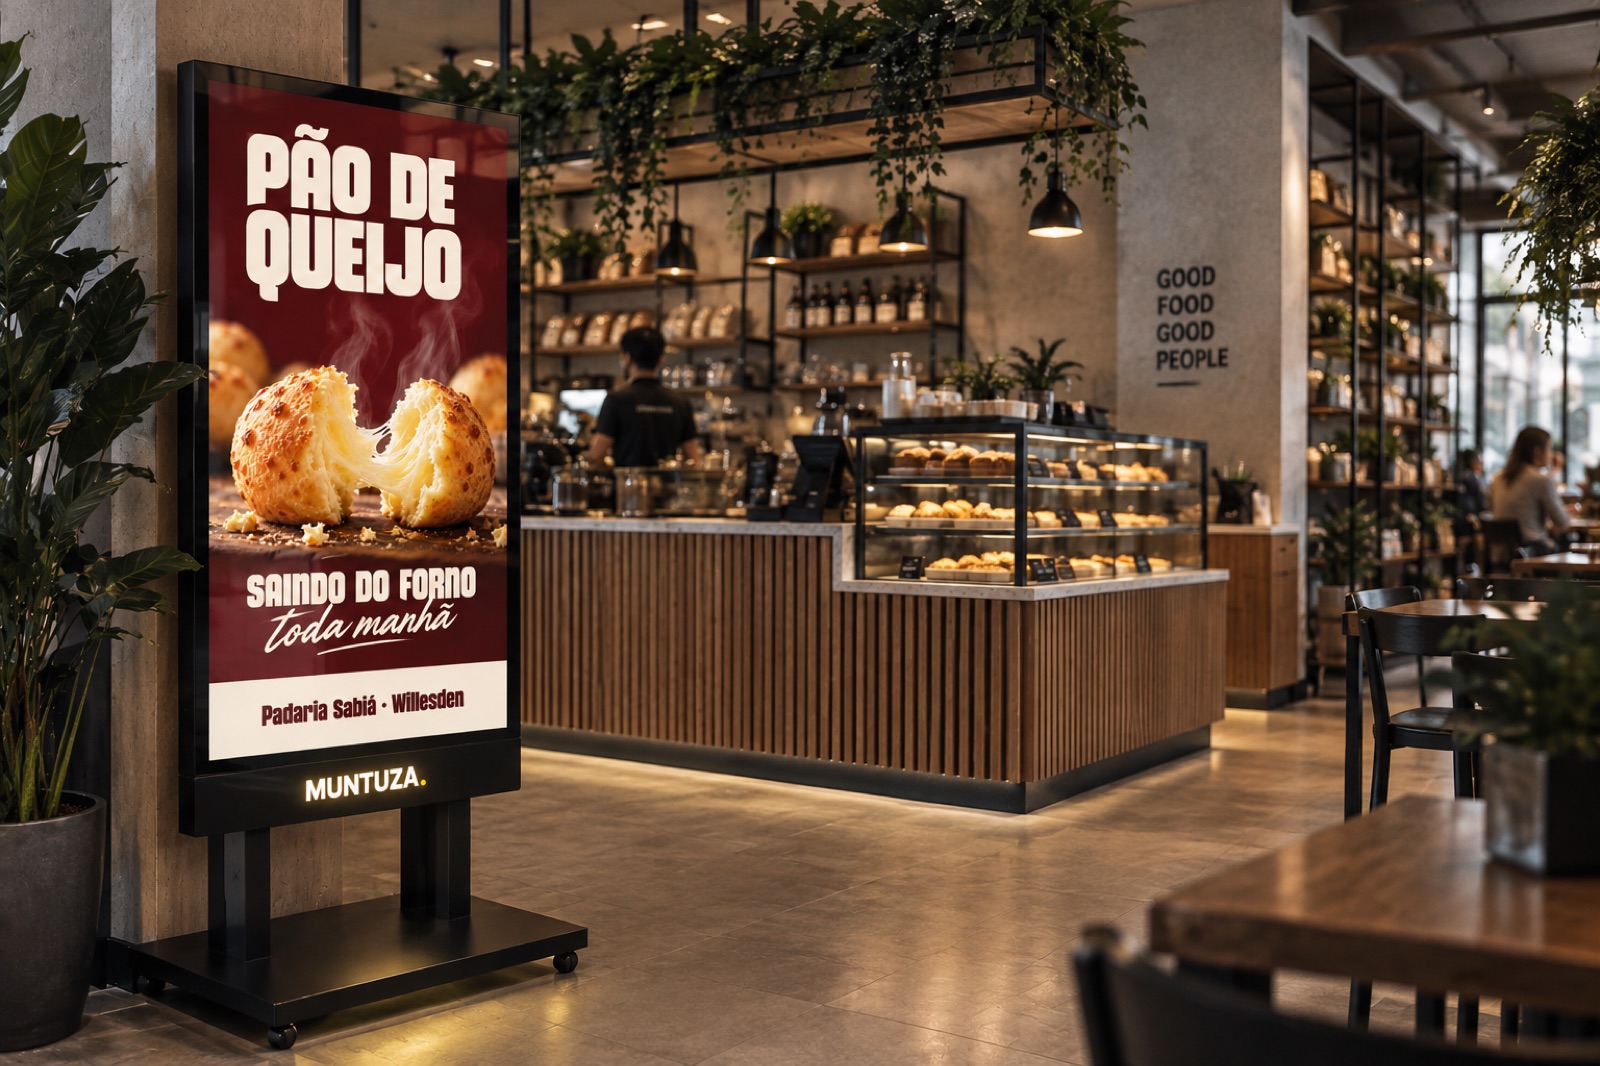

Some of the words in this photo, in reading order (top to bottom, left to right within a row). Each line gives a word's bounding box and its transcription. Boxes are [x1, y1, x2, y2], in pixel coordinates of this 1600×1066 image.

[247, 123, 371, 214] PÃO
[390, 152, 455, 225] DE
[246, 209, 462, 302] QUEIJO
[1156, 265, 1216, 289] GOOD
[1157, 292, 1214, 316] FOOD
[1156, 319, 1215, 343] GOOD
[1156, 347, 1229, 371] PEOPLE
[355, 569, 390, 603] DO
[263, 603, 353, 654] toda
[352, 598, 458, 638] manhã
[261, 700, 328, 727] Padaria
[333, 694, 377, 719] Sabiá
[392, 688, 465, 714] Willesden
